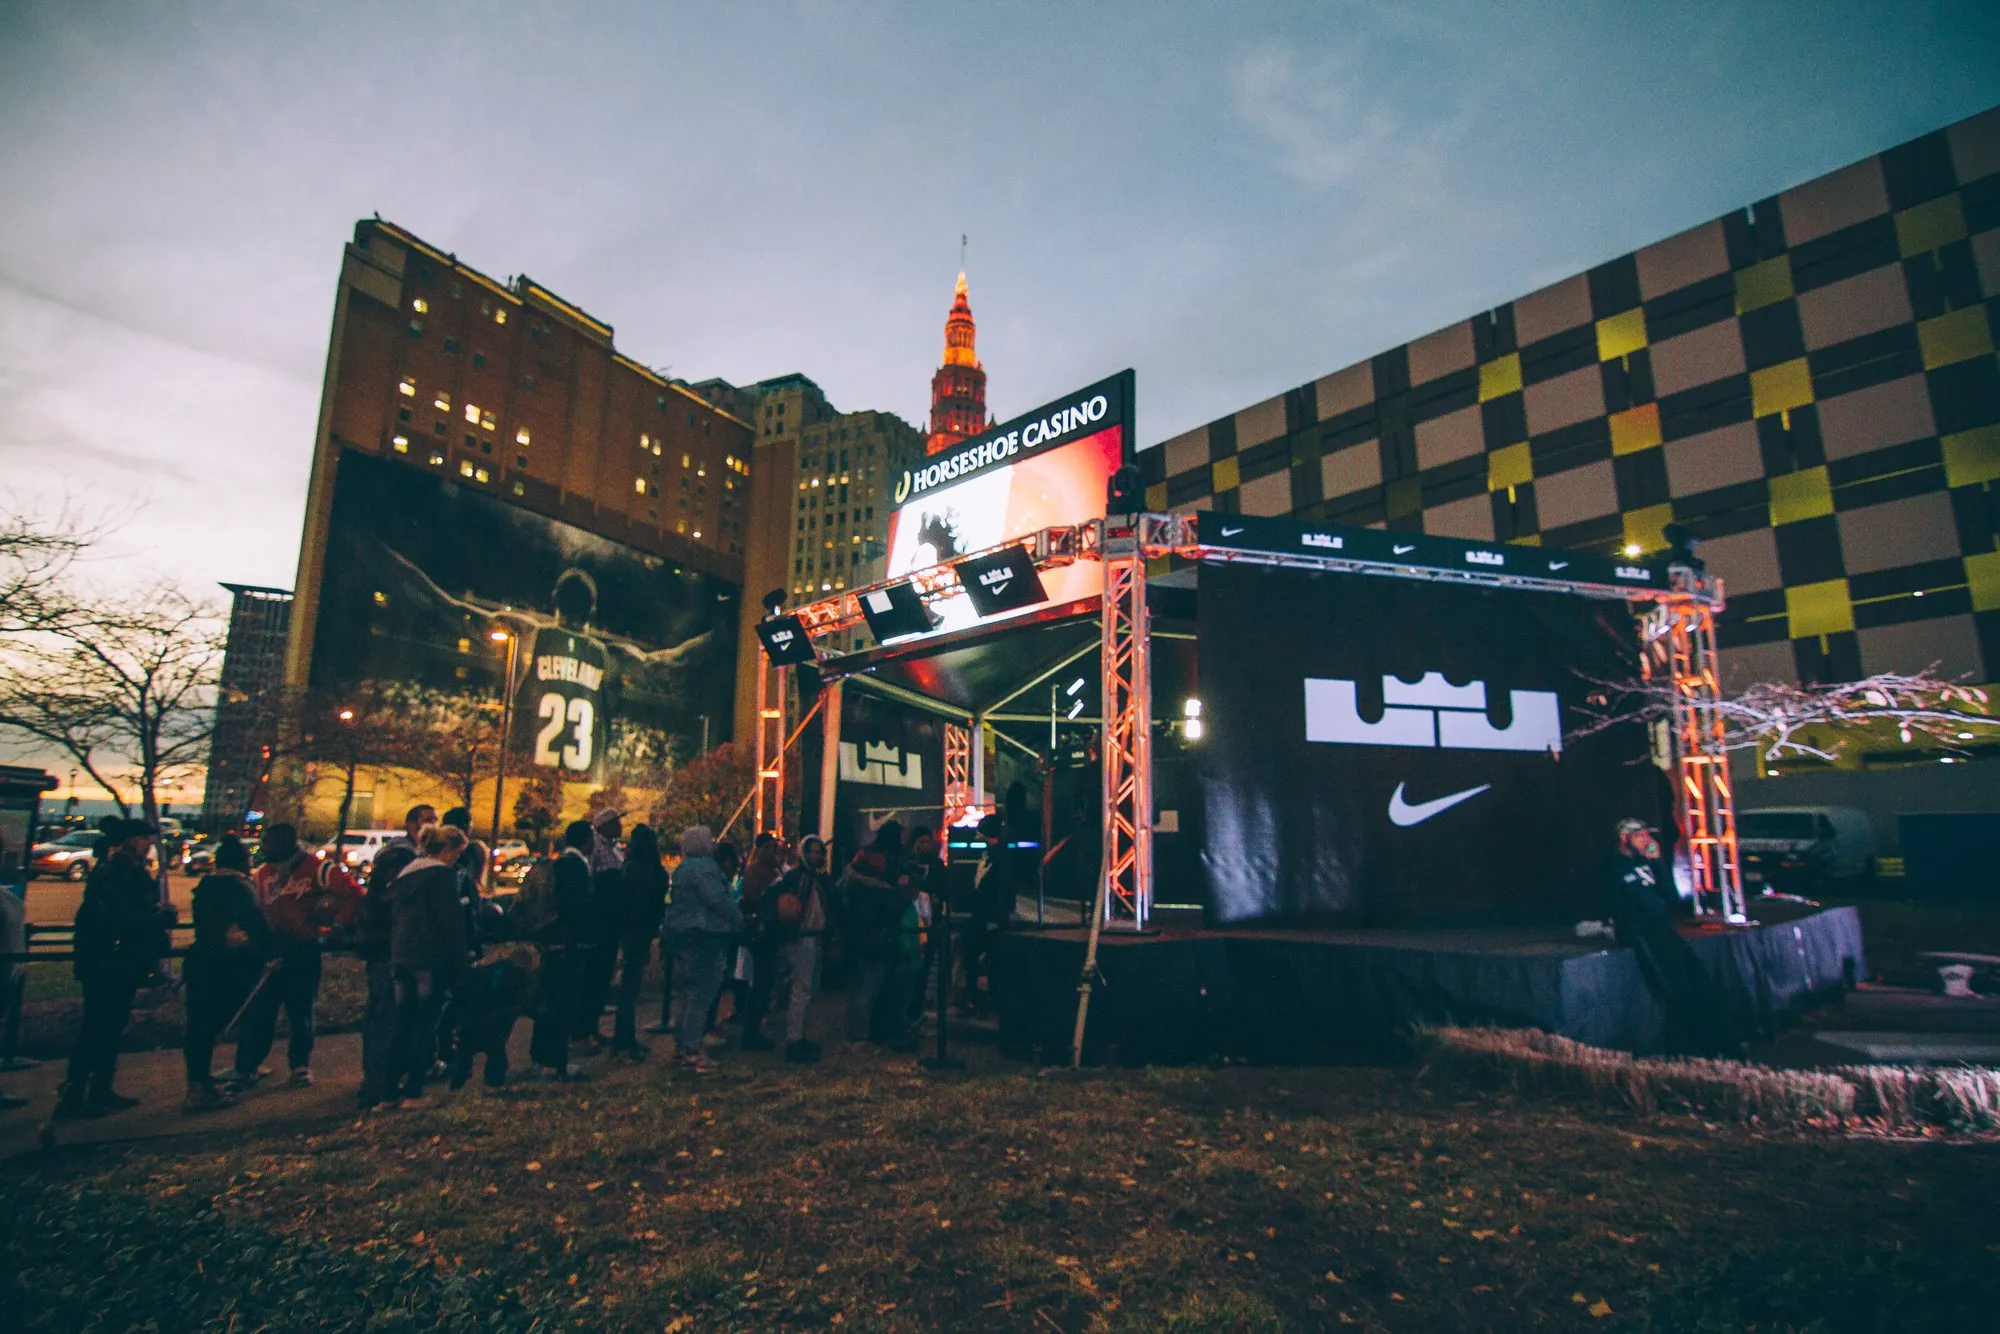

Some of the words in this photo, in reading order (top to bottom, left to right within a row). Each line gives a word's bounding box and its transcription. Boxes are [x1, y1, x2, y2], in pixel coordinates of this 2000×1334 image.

[912, 431, 1019, 493] HORSESHOE
[1022, 395, 1108, 448] CASINO
[535, 692, 594, 771] 23
